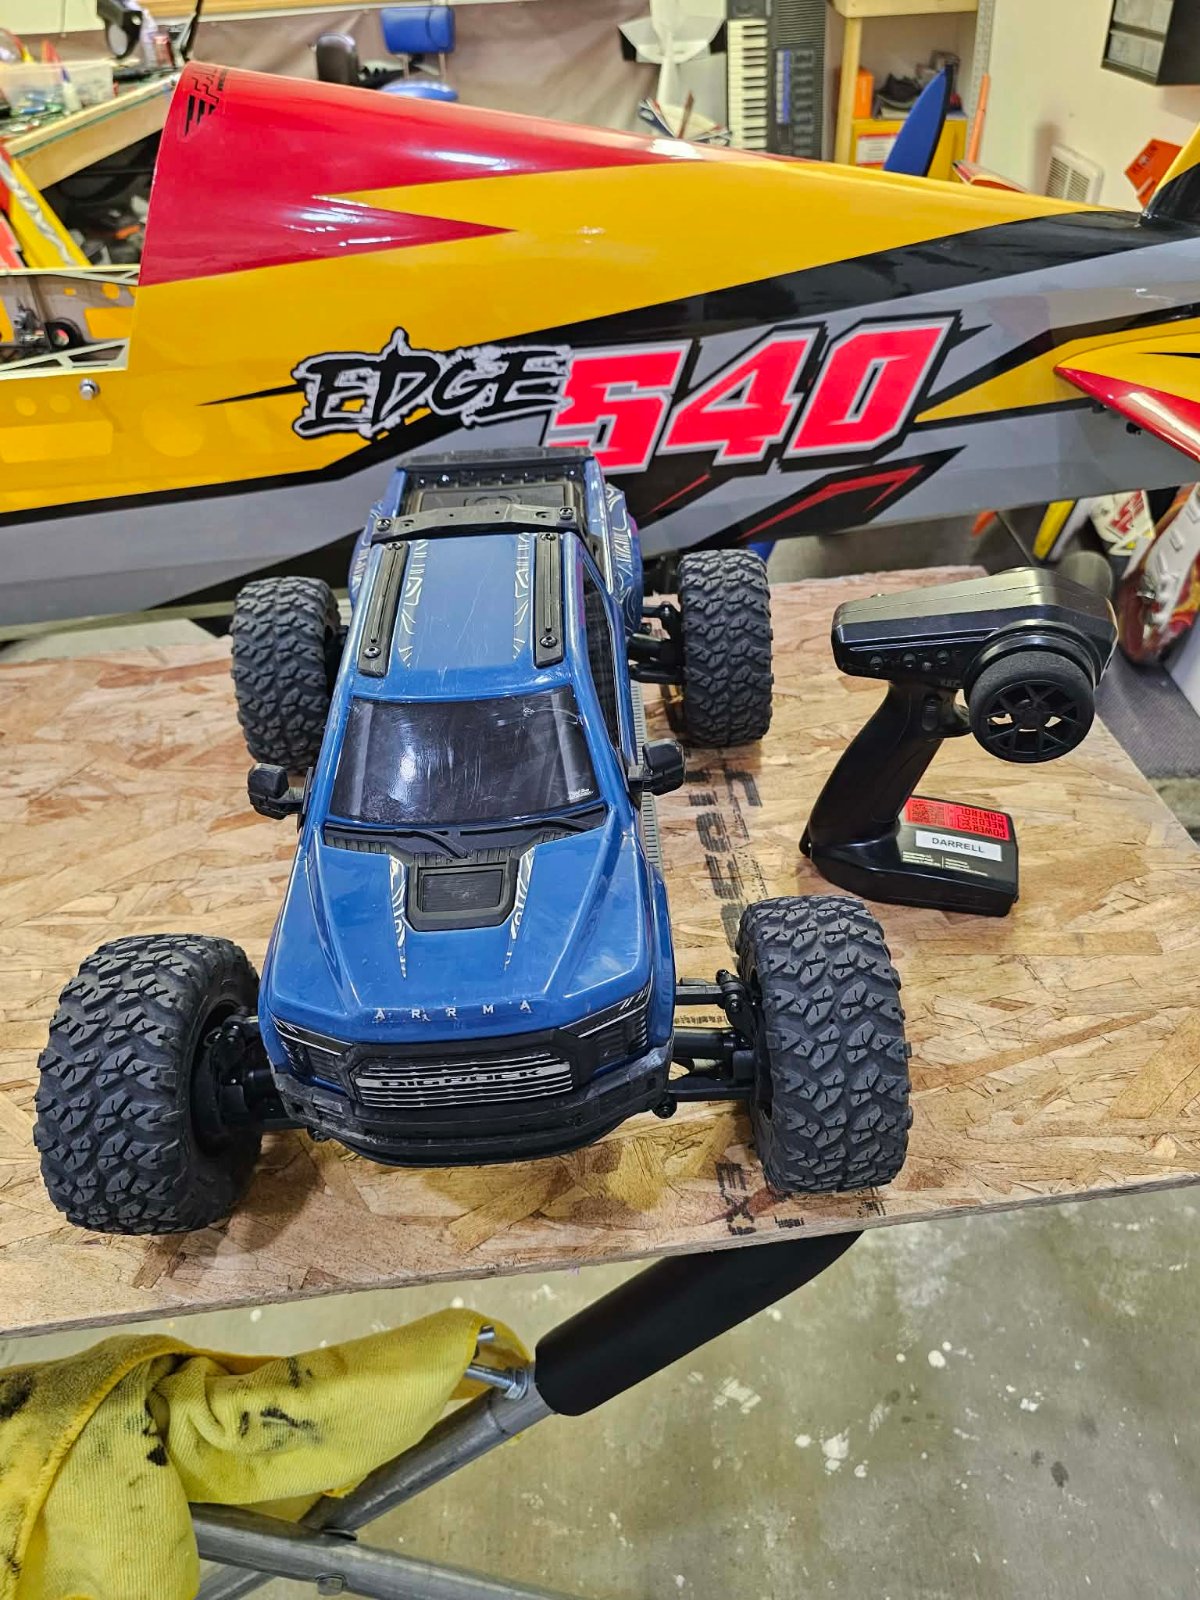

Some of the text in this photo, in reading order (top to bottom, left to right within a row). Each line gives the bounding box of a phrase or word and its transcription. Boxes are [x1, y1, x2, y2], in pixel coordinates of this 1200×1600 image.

[291, 312, 960, 474] EDGE 540
[931, 837, 985, 854] DARRELL
[374, 1000, 531, 1020] ARRMA
